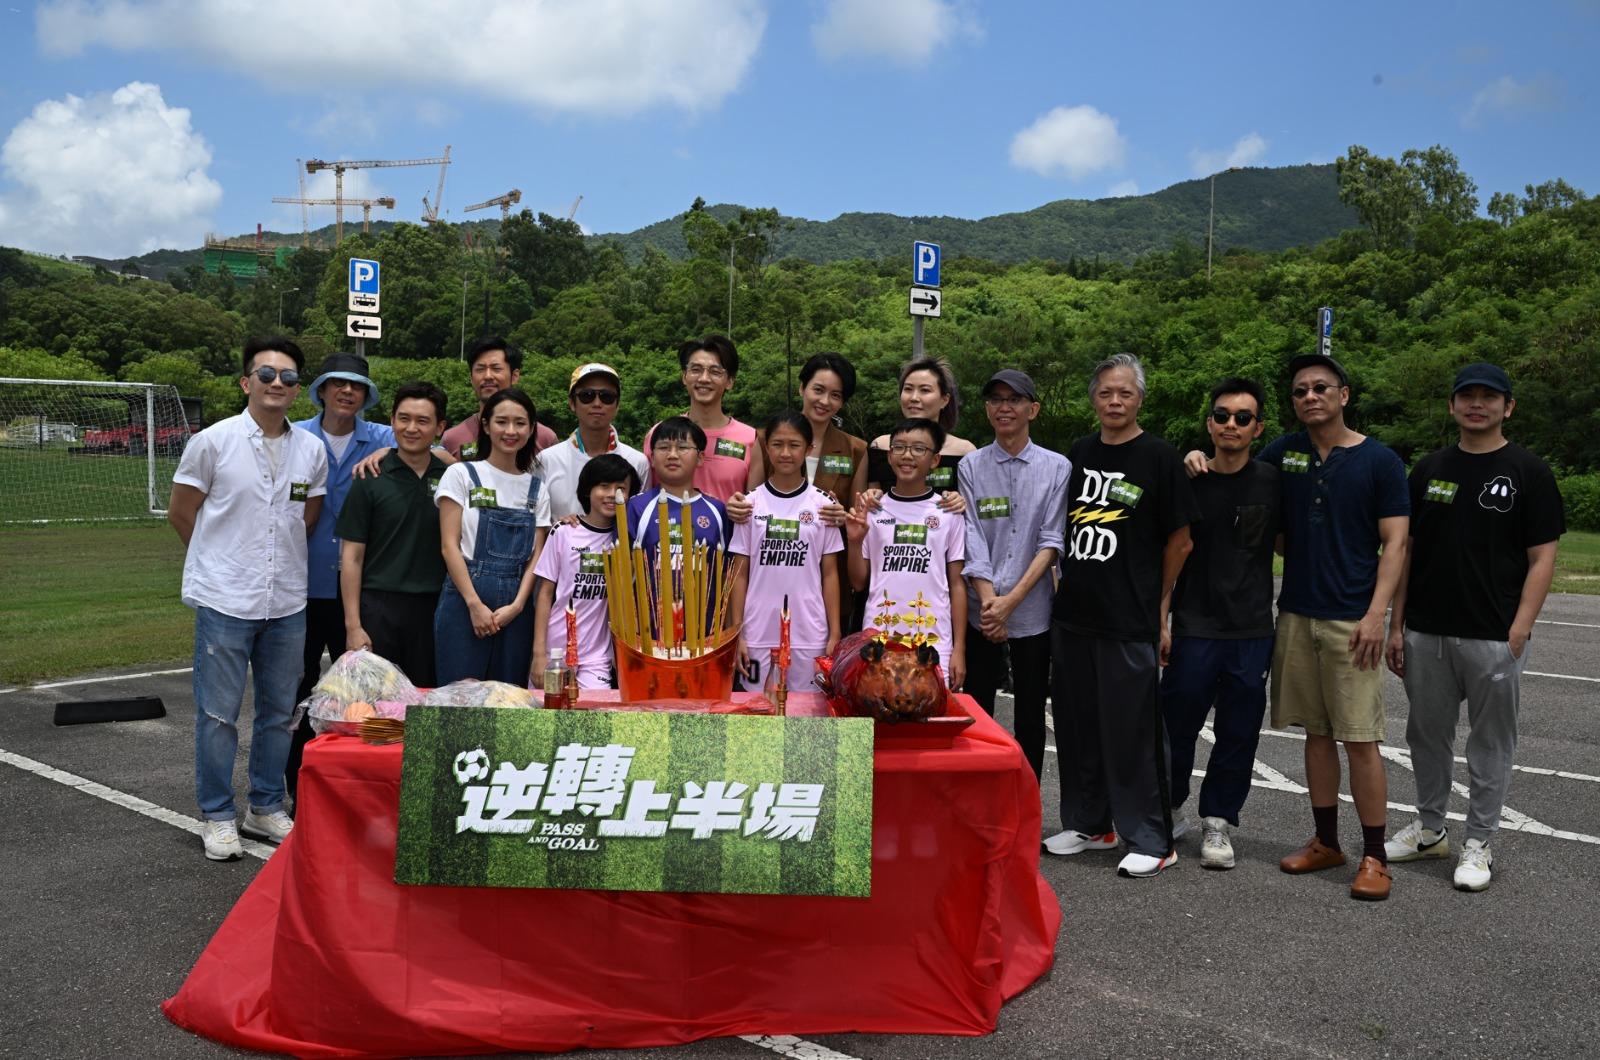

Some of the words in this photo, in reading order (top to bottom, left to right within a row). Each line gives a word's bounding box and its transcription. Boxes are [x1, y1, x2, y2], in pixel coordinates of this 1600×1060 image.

[919, 245, 936, 281] P
[354, 262, 374, 291] P
[1324, 309, 1331, 334] P
[760, 539, 793, 551] SPORTS
[883, 545, 916, 556] SPORTS
[759, 550, 807, 566] EMPIRE
[882, 556, 931, 574] EMPIRE
[574, 572, 606, 585] SPORTS
[572, 584, 608, 600] EMPI
[456, 742, 825, 842] 逆轉上半場
[540, 822, 585, 836] PASS
[527, 836, 549, 844] AND
[547, 837, 600, 851] GOAL
